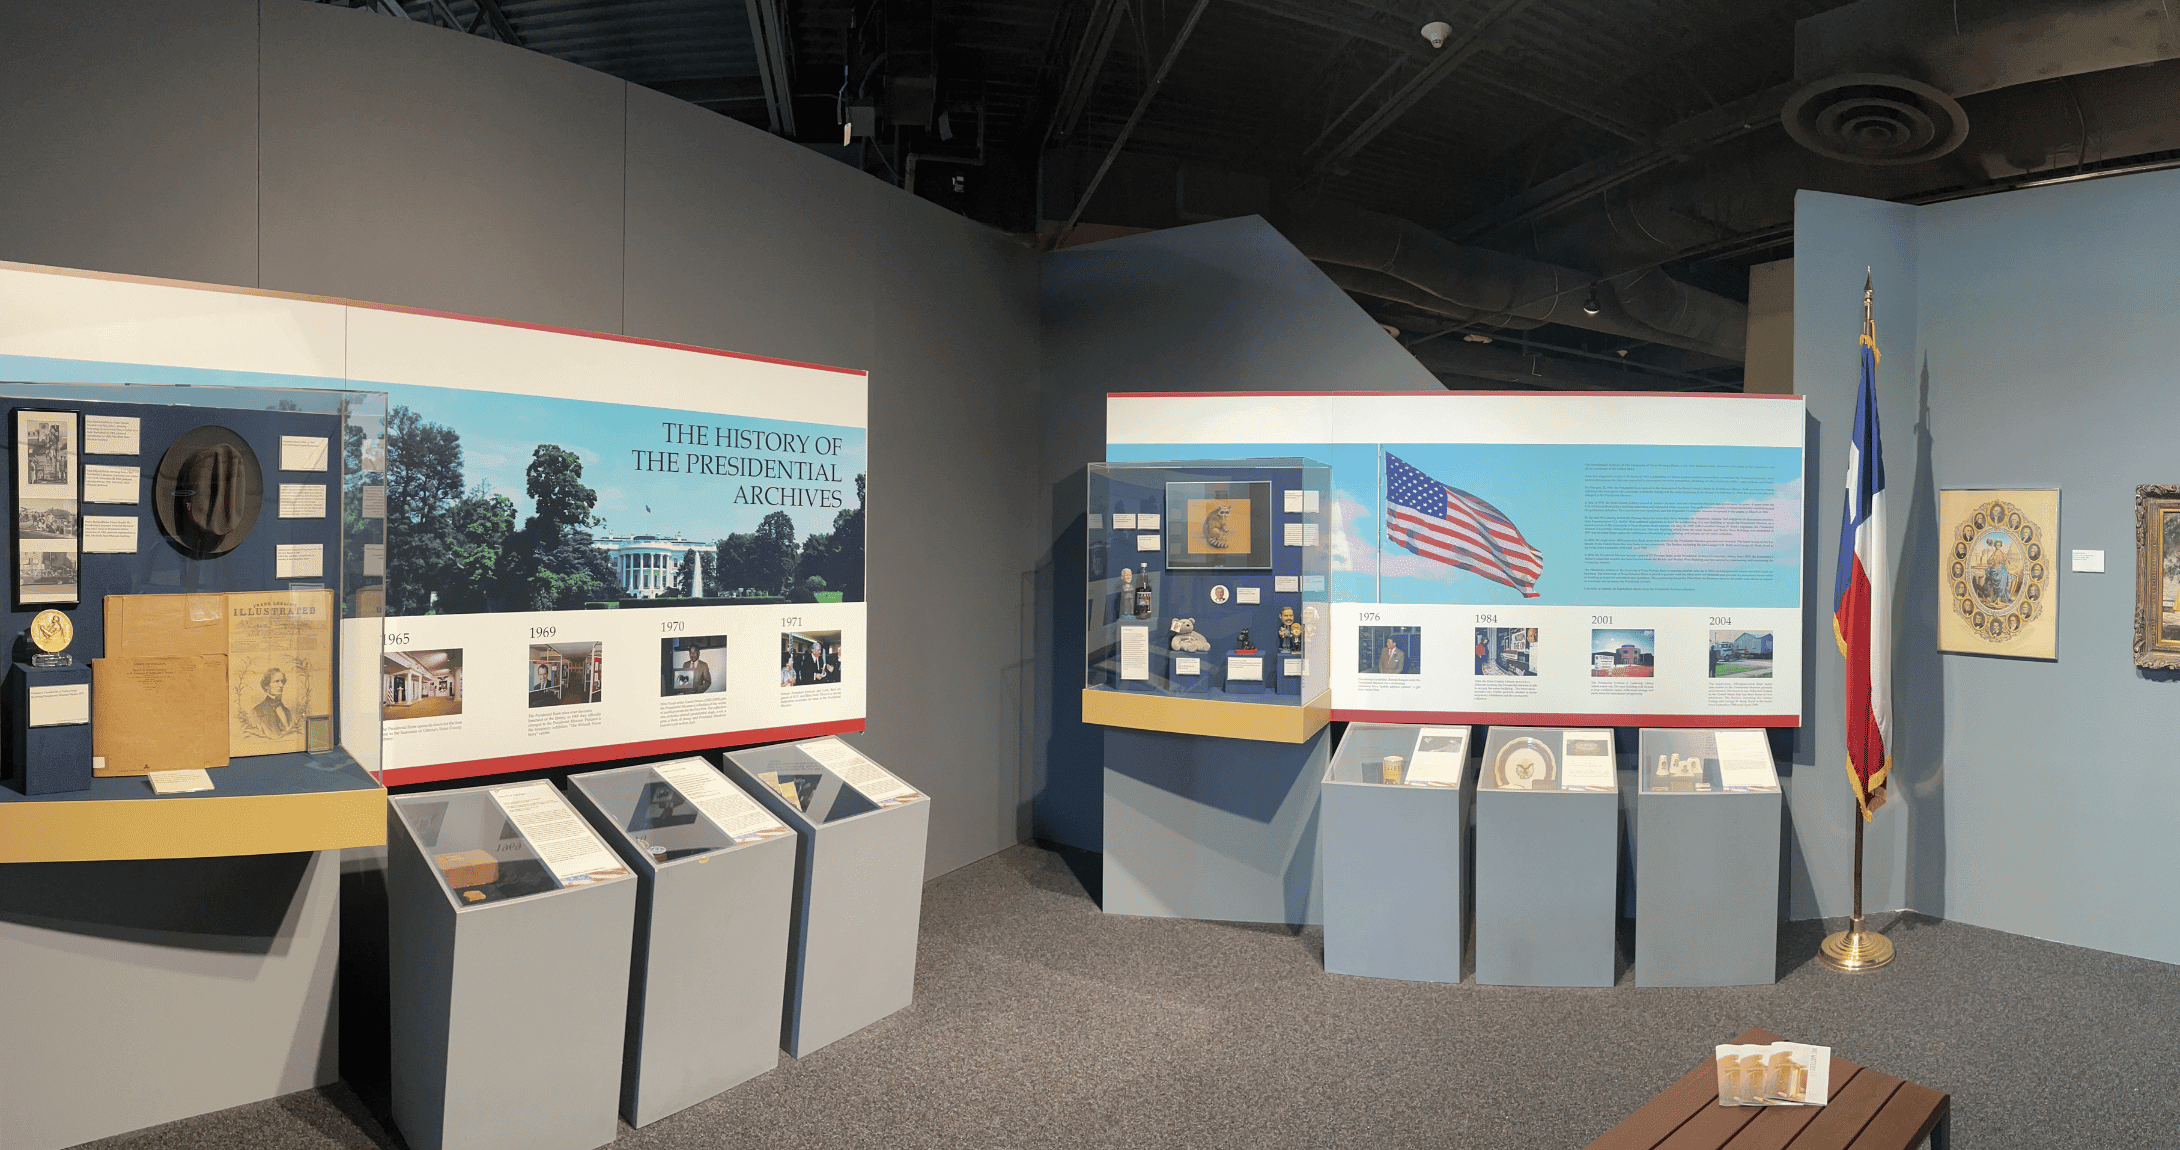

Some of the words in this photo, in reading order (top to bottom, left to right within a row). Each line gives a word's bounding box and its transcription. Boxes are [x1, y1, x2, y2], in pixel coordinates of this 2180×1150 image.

[663, 422, 709, 446] THE
[715, 427, 810, 454] HISTORY
[815, 436, 843, 456] OF
[632, 449, 679, 473] THE
[686, 453, 843, 483] PRESIDENTIAL
[733, 485, 843, 509] ARCHIVES
[233, 607, 316, 617] ILLUSTRATED
[1359, 612, 1381, 622] 1976
[781, 616, 802, 628] 1971
[1475, 614, 1497, 624] 1984
[1591, 615, 1613, 625] 2001
[1709, 616, 1732, 626] 2004
[529, 626, 556, 639] 1969
[661, 620, 685, 633] 1970
